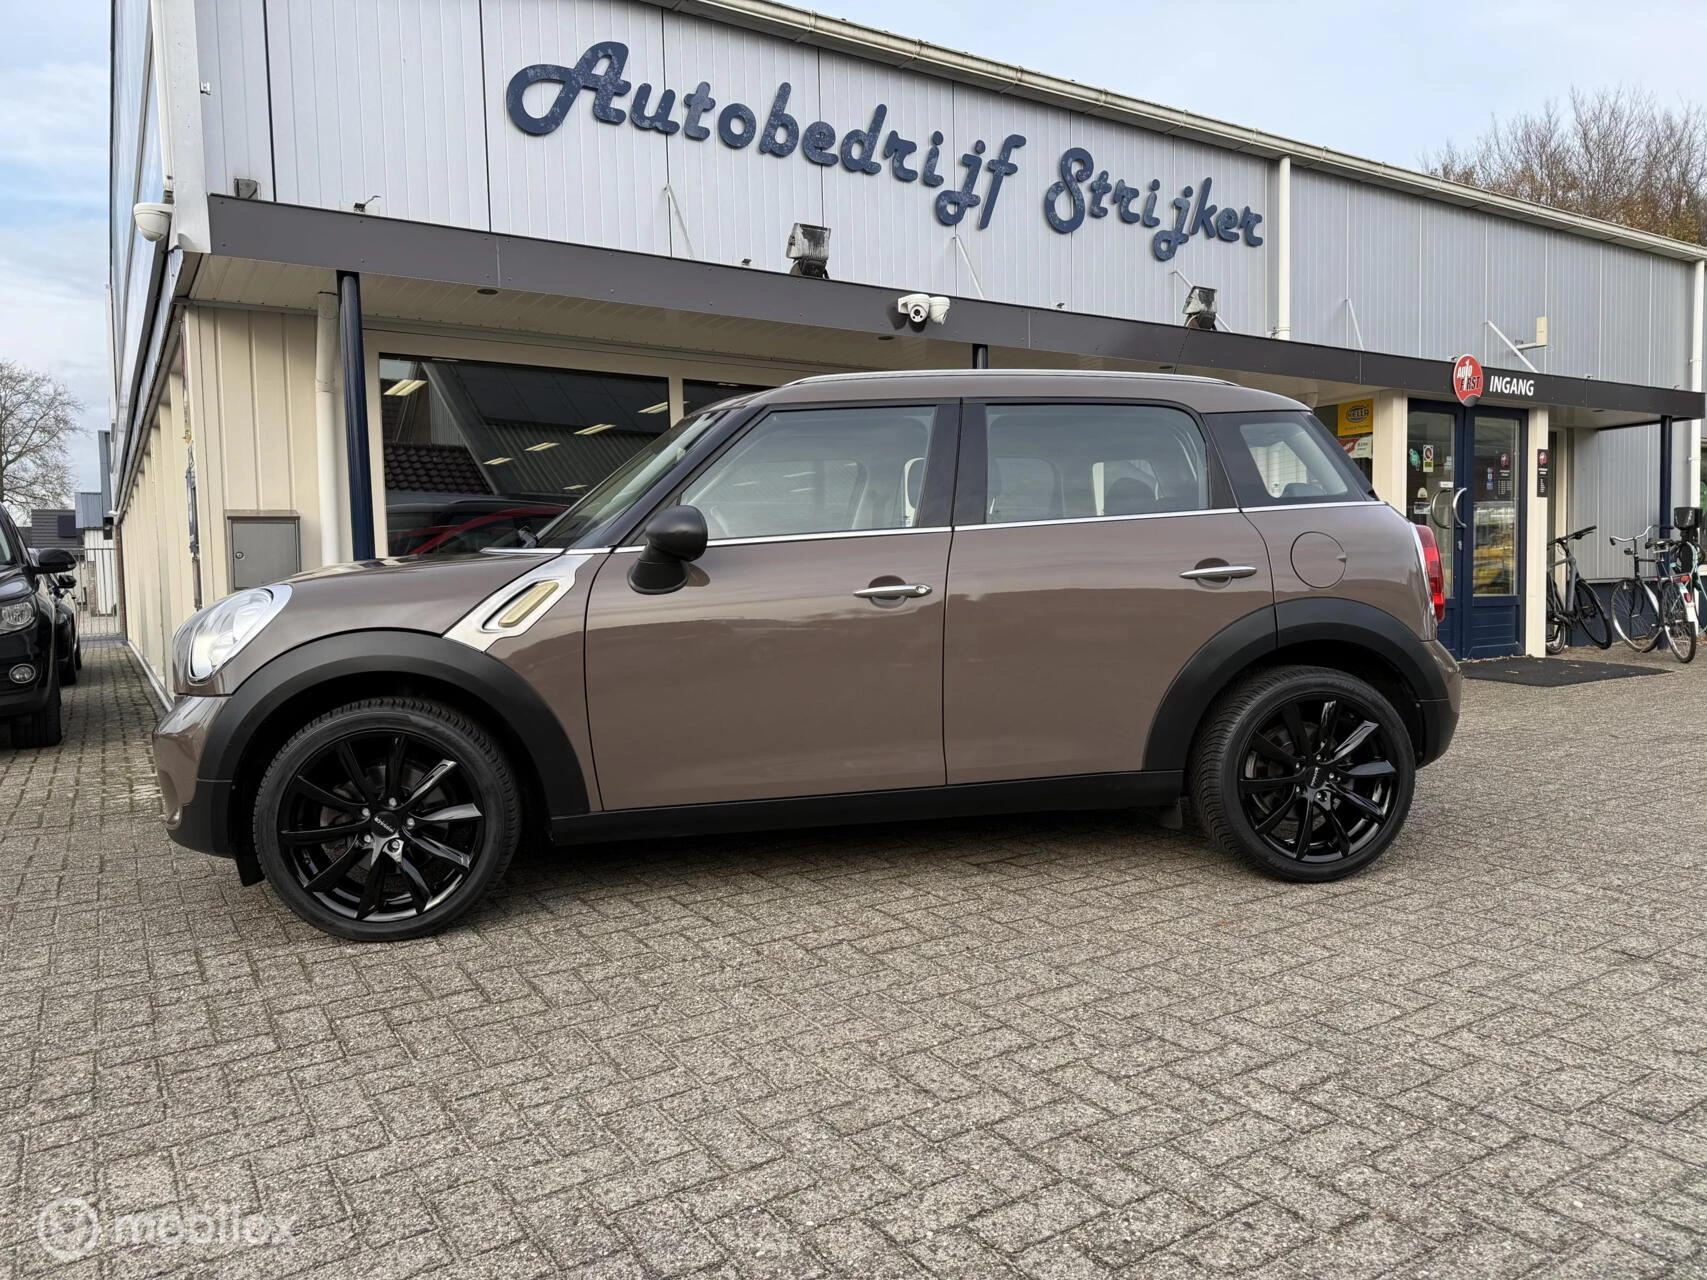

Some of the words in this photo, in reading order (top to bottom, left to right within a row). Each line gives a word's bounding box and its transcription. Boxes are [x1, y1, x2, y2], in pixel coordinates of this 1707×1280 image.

[505, 40, 1027, 230] Autobedrijf
[1044, 147, 1264, 262] Strijker
[1489, 375, 1535, 397] INGANG
